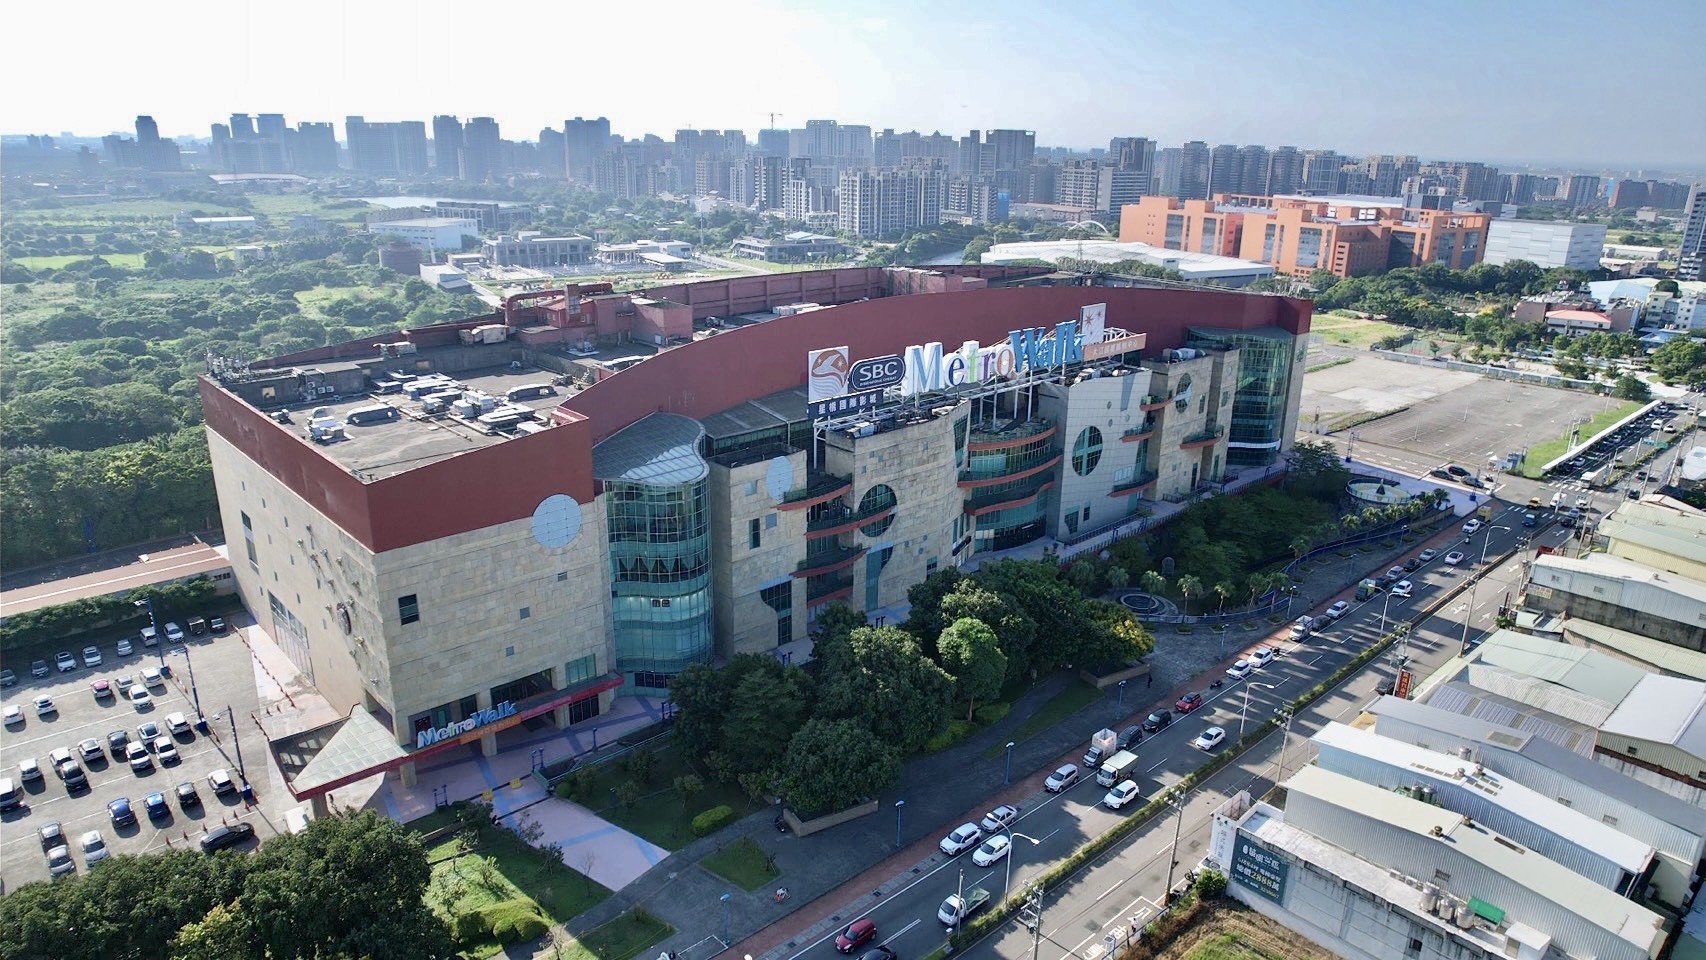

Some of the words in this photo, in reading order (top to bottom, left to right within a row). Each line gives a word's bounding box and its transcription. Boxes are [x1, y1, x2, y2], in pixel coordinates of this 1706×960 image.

[859, 362, 898, 381] SBC
[901, 320, 1085, 396] MetroWalk
[417, 701, 517, 748] MetroWalk
